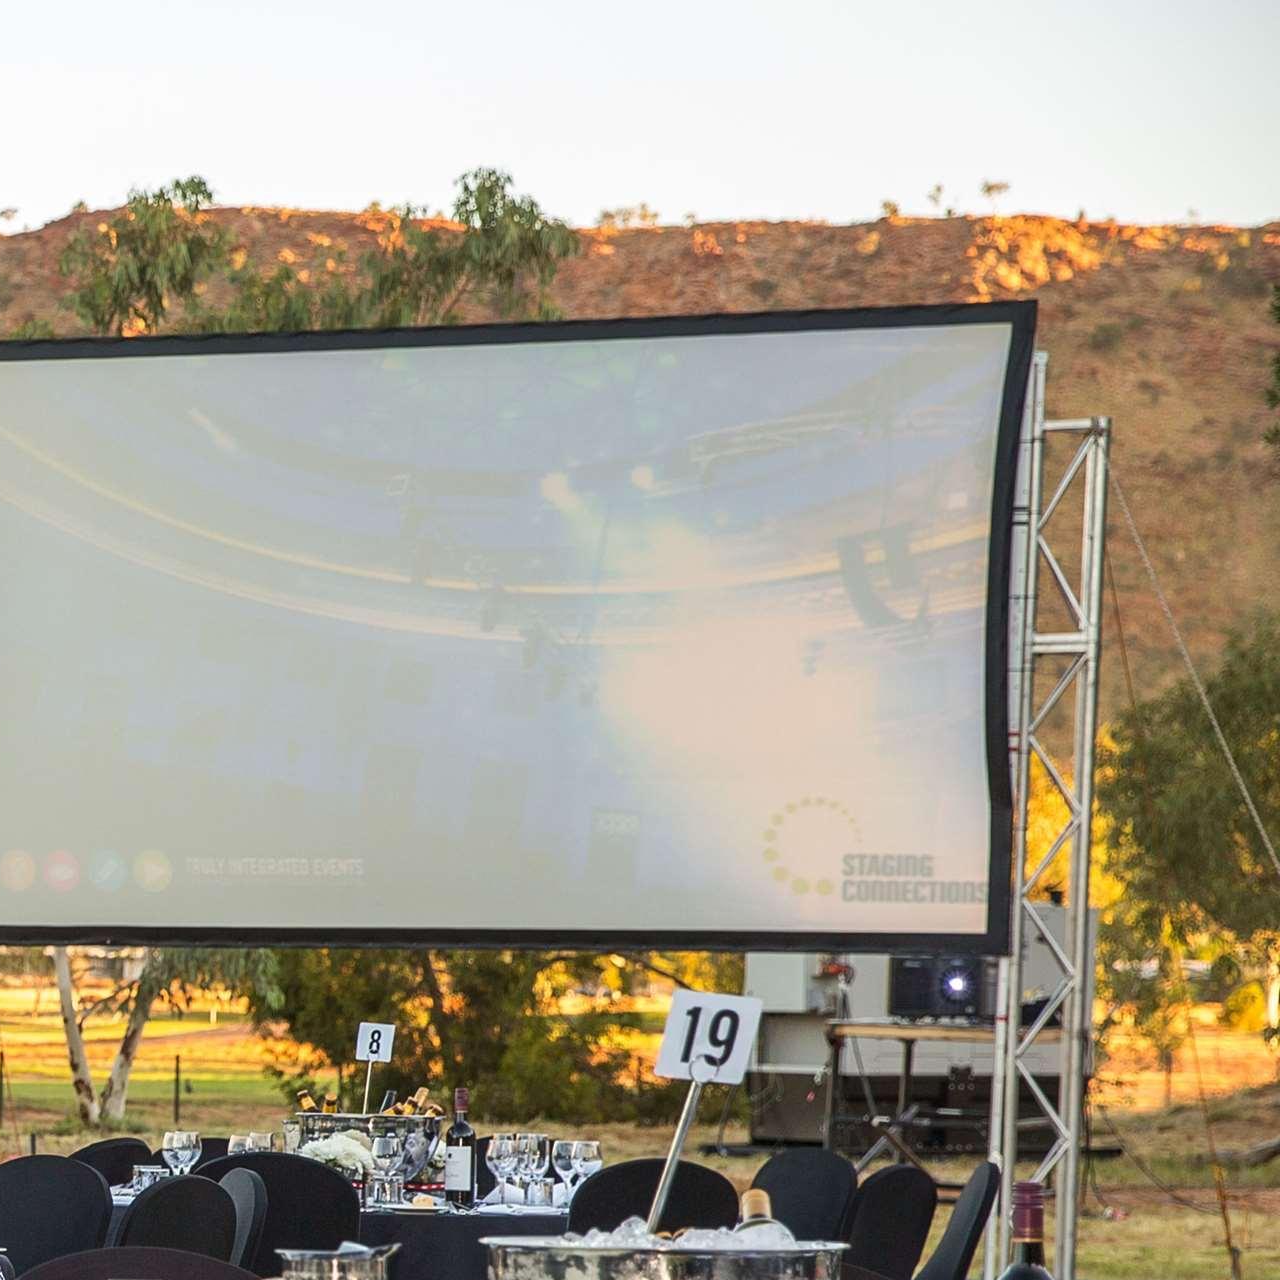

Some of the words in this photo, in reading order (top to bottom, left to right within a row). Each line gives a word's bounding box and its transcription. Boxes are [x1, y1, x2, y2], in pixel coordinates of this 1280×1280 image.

[185, 856, 225, 875] TRULY
[312, 856, 364, 875] EVENTS
[842, 854, 935, 878] STAGING
[842, 880, 989, 903] CONNECTIONS
[369, 1029, 382, 1054] 8
[680, 1006, 740, 1067] 19
